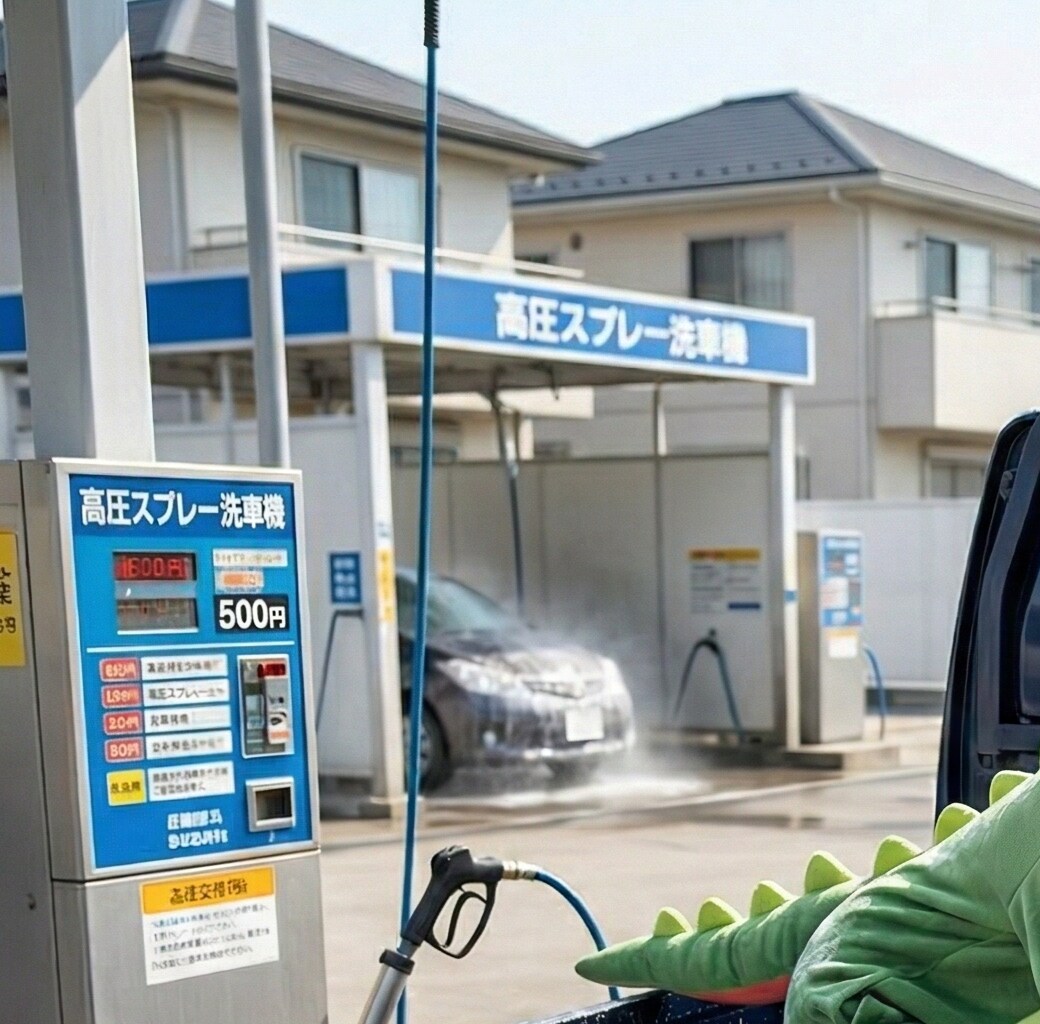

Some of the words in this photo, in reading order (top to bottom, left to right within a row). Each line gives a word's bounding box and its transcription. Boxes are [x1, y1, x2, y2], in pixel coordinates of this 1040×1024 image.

[494, 291, 749, 366] 高圧スプレー洗車機
[78, 487, 286, 530] 高圧スプレー洗車機
[218, 598, 286, 630] 500円
